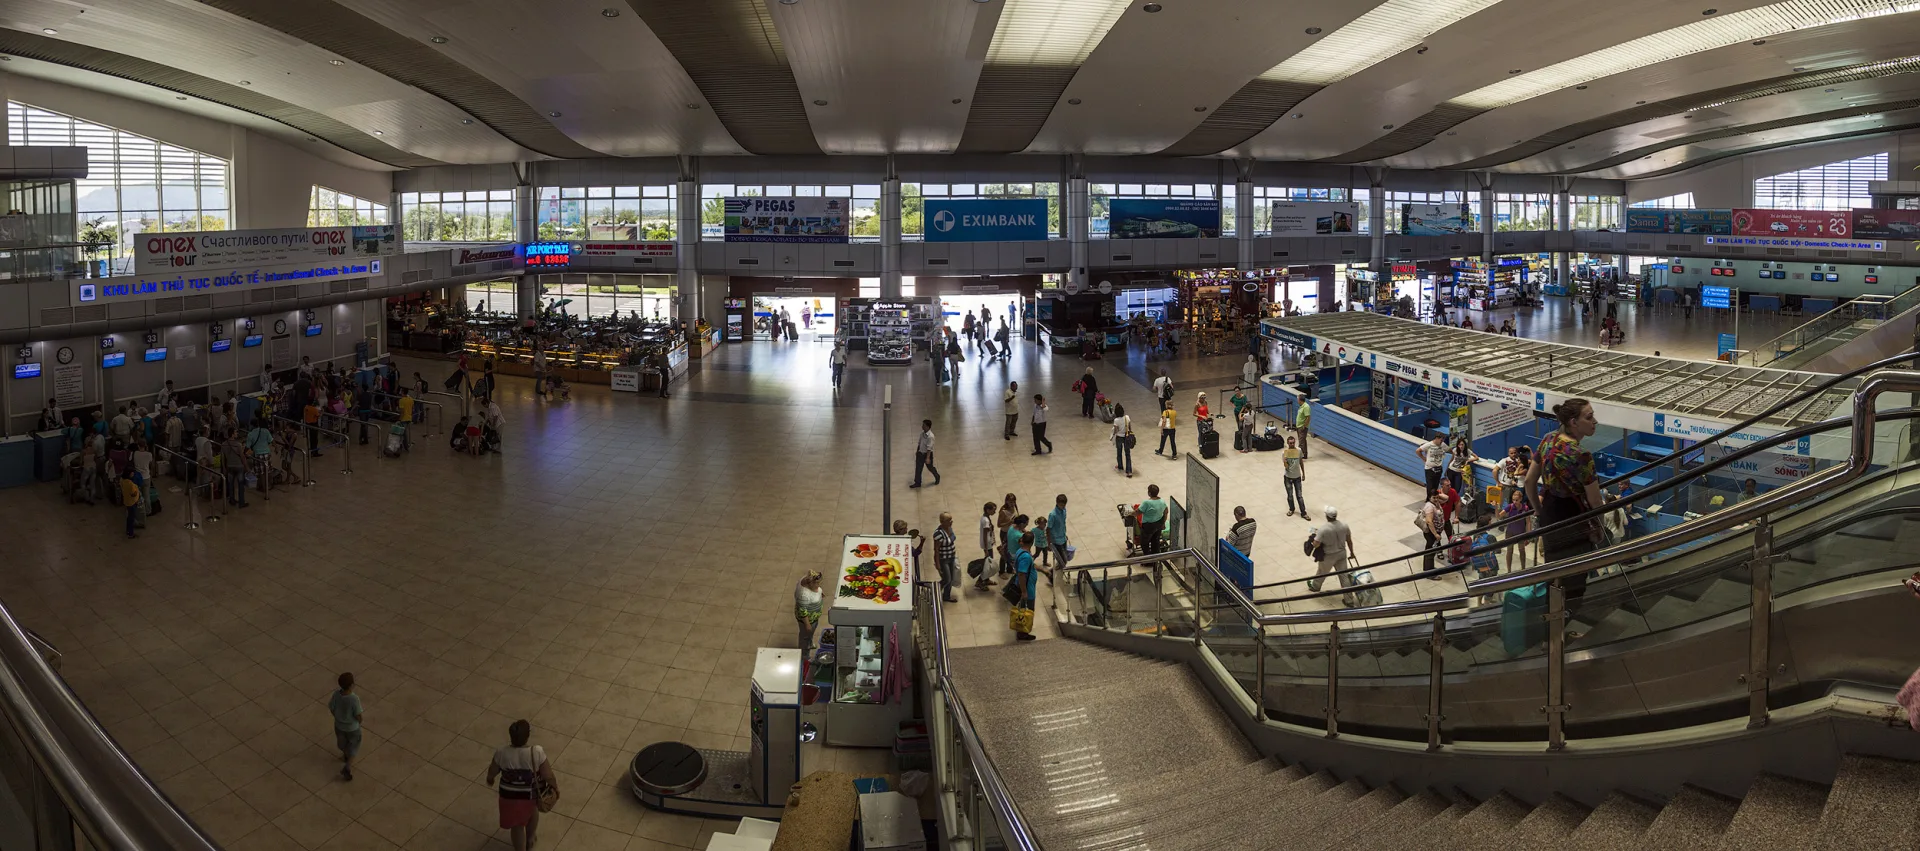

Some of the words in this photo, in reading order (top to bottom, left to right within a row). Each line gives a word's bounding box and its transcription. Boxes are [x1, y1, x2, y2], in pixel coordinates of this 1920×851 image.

[756, 200, 796, 212] PEGAS
[963, 215, 1036, 226] EXIMBANK
[1630, 216, 1658, 226] Sanna
[1830, 218, 1846, 235] 23
[202, 234, 278, 248] Счастливого
[281, 232, 308, 247] пути!
[312, 230, 346, 245] anex
[148, 237, 197, 254] anex
[328, 246, 346, 256] tour
[170, 254, 197, 267] tour
[459, 247, 516, 264] Restaurant
[103, 284, 130, 296] KHU
[132, 280, 157, 294] LÀM
[162, 276, 184, 291] THỦ
[188, 278, 211, 291] TỤC
[214, 271, 243, 287] QUỐC
[102, 339, 112, 348] 34
[147, 334, 156, 342] 33
[20, 349, 31, 357] 35
[1402, 366, 1417, 376] PEGAS
[1450, 392, 1467, 406] PEGA
[1667, 427, 1690, 435] EXIMBANK
[1711, 456, 1758, 470] EBANK
[1775, 466, 1797, 476] SÓNG
